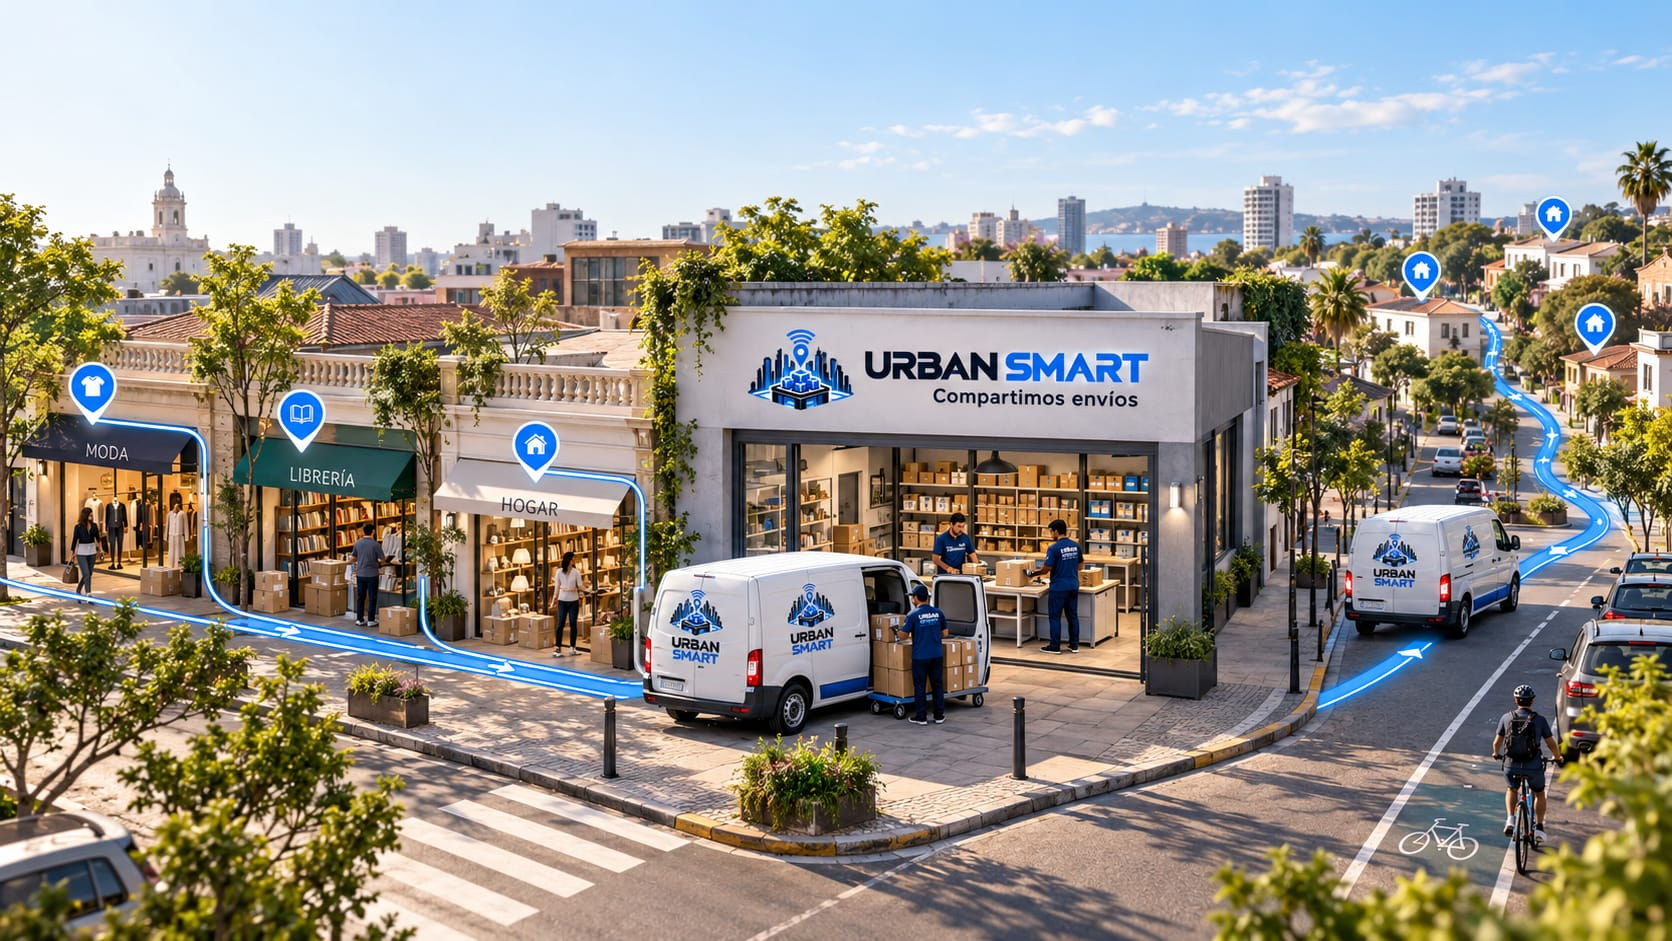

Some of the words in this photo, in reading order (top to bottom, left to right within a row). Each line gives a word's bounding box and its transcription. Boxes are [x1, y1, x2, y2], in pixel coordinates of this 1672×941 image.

[864, 351, 998, 381] URBAN
[1005, 352, 1149, 383] SMART
[933, 388, 1065, 407] Compartimos
[1071, 390, 1138, 407] envíos
[86, 443, 128, 461] MODA
[290, 467, 355, 488] LIBRERÍA
[501, 497, 558, 516] HOGAR
[1373, 568, 1415, 579] URBAN
[1374, 578, 1414, 588] SMART
[790, 627, 833, 644] URBAN
[672, 637, 720, 653] URBAN
[792, 639, 833, 655] SMART
[672, 649, 719, 664] SMART
